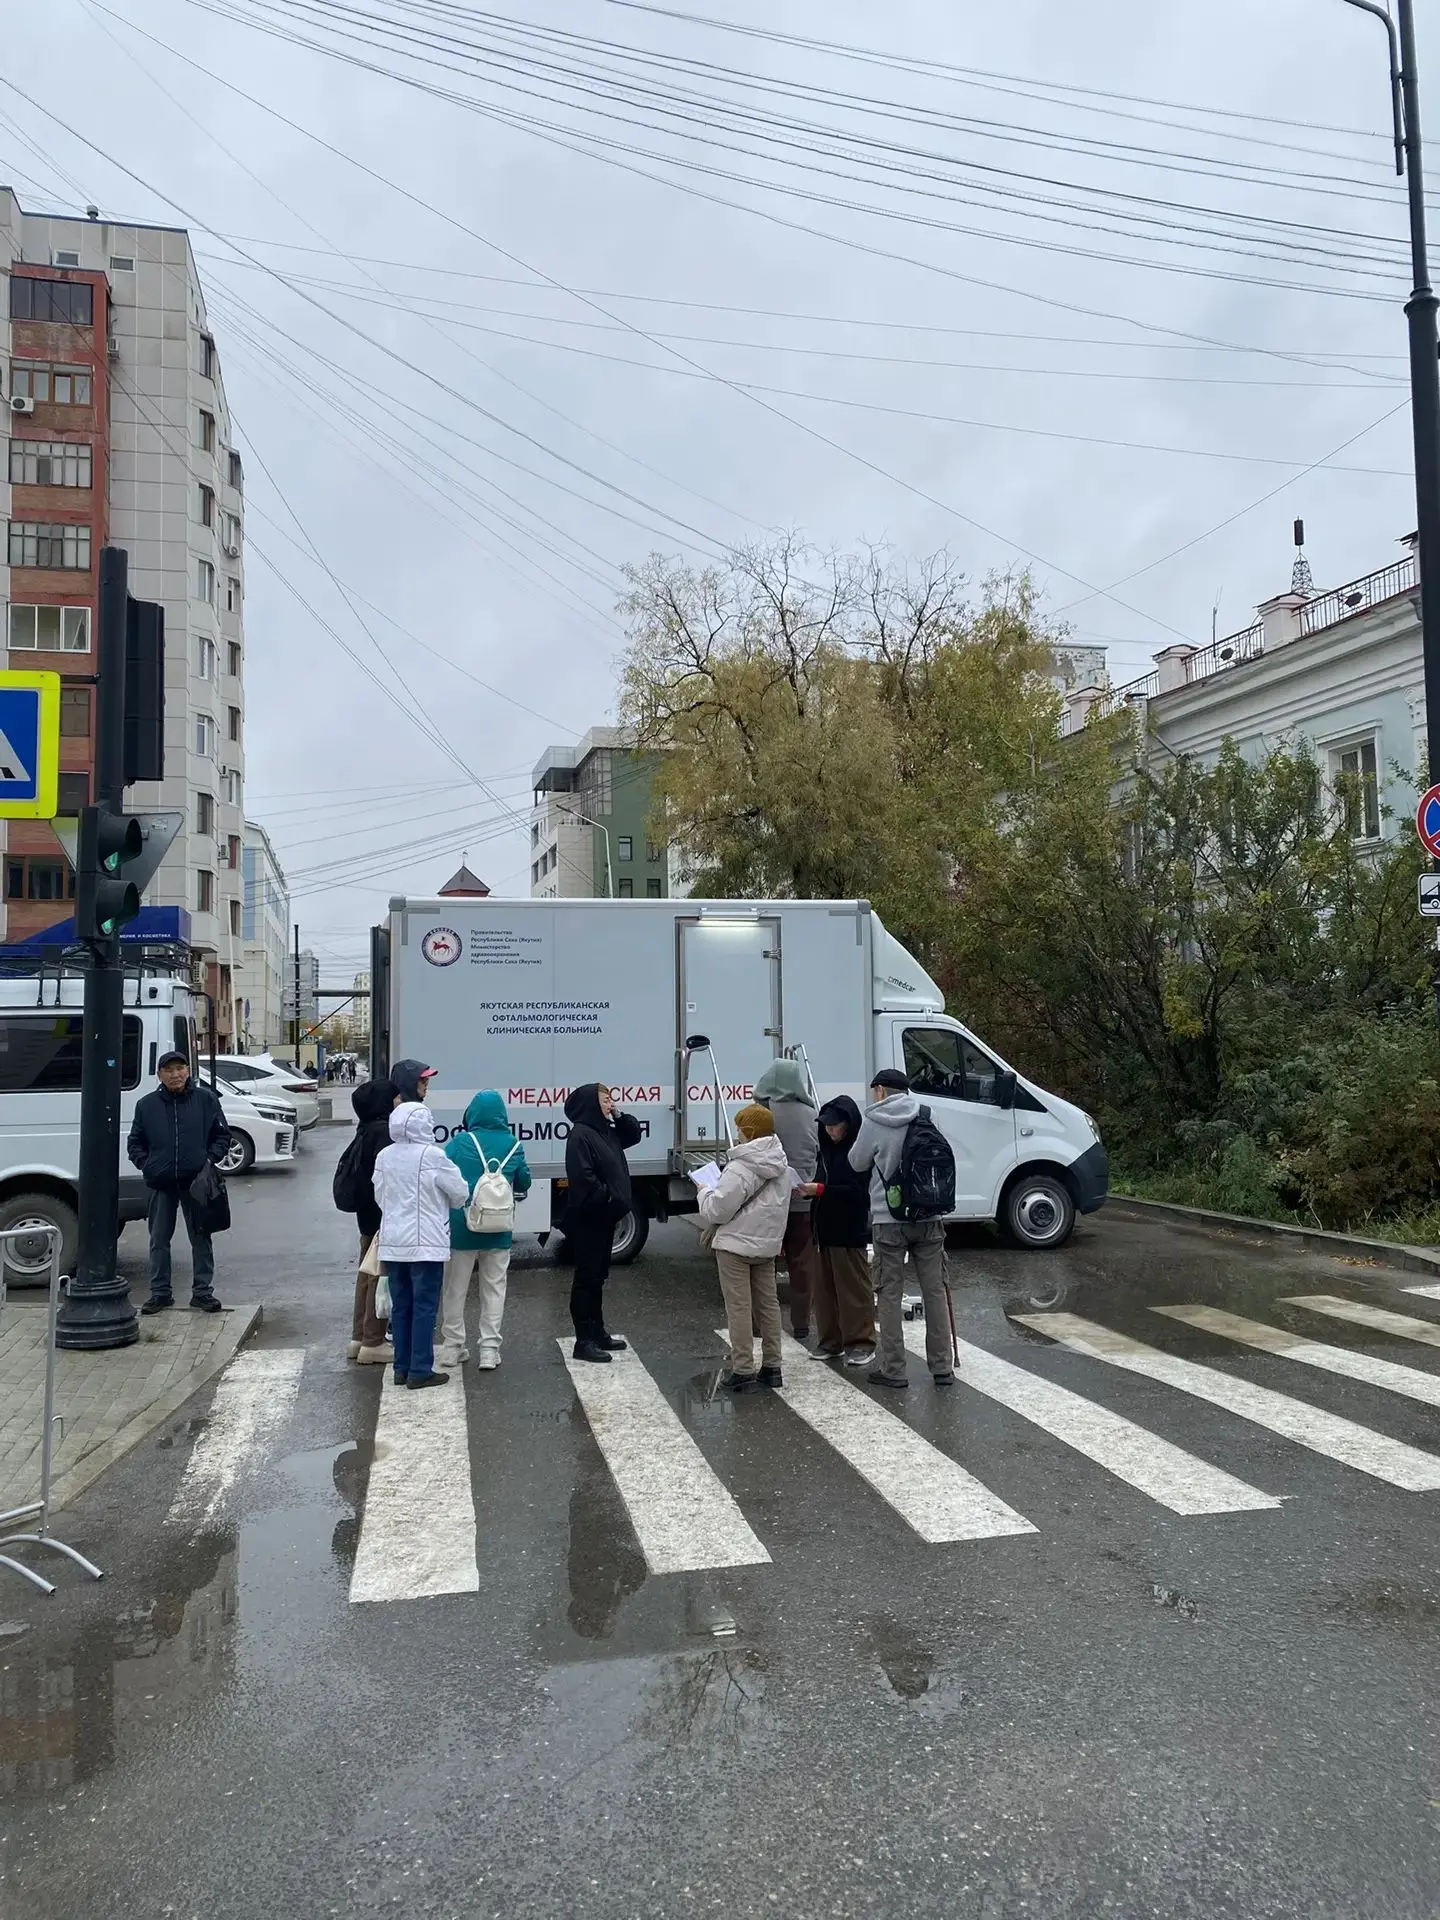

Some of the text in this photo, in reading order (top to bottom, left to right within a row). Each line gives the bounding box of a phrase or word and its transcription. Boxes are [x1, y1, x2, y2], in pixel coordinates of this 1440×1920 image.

[480, 1001, 610, 1010] ЯКУТСКАЯ РЕСПУБЛИКАНСКАЯ
[492, 1013, 598, 1022] ОФТАЛЬМОЛОГИЧЕСКАЯ
[486, 1026, 602, 1035] КЛИНИЧЕСКАЯ БОЛЬНИЦА
[508, 1086, 660, 1107] МЕДИСКАЯ
